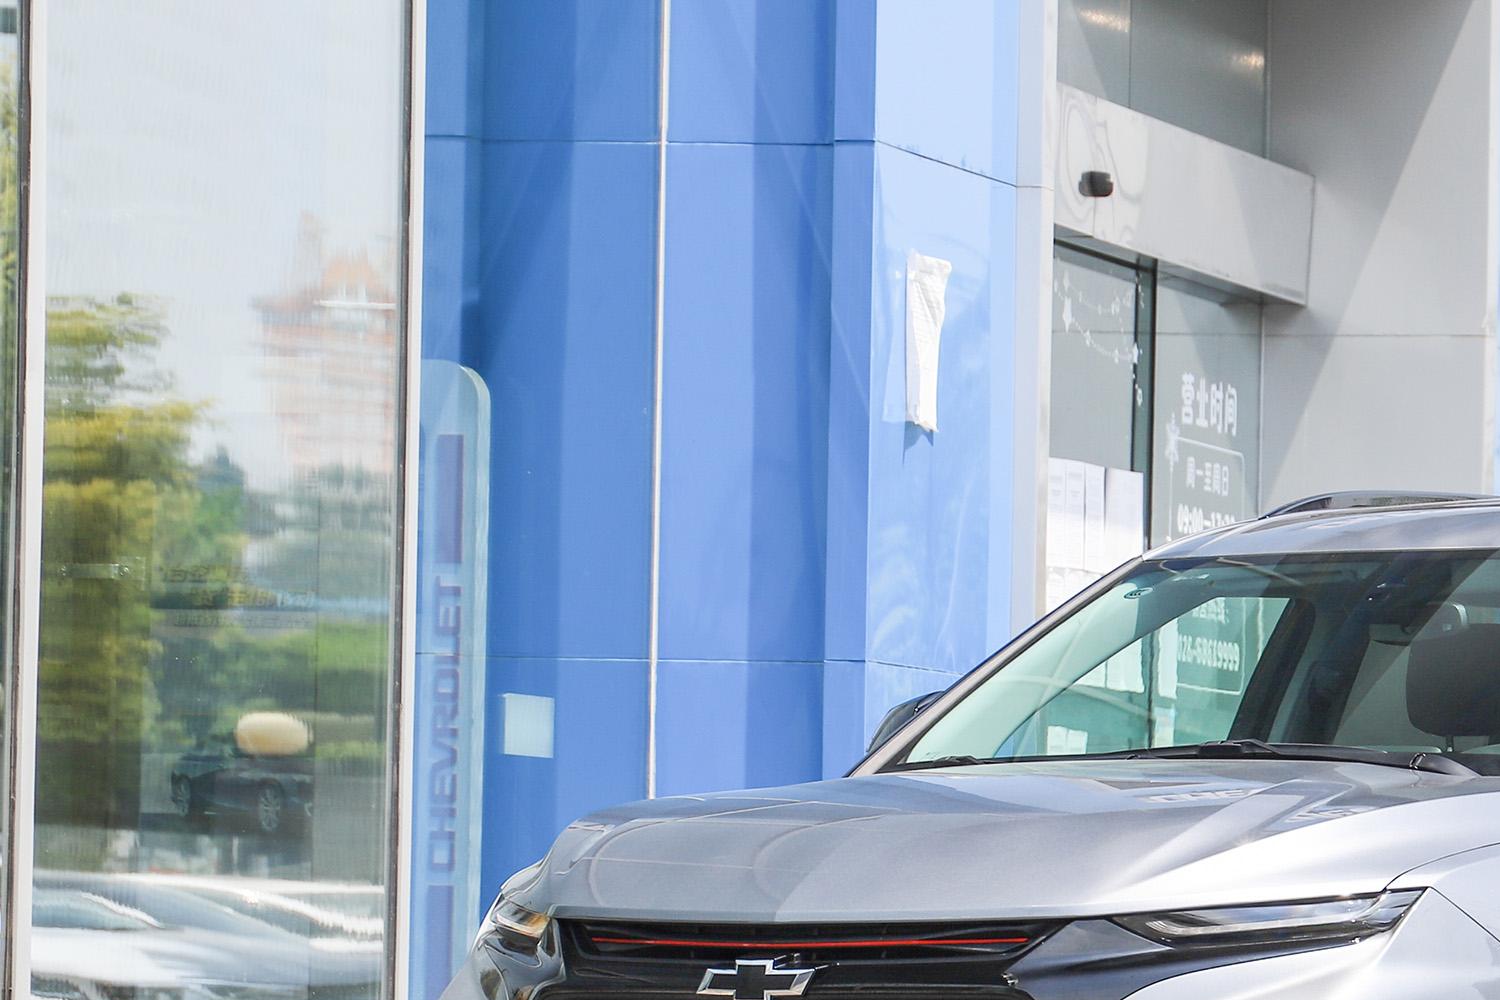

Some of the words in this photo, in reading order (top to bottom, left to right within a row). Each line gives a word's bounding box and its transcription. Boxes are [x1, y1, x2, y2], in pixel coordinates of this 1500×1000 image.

[1181, 371, 1238, 437] 营业时间
[428, 575, 464, 873] CHEVROLET
